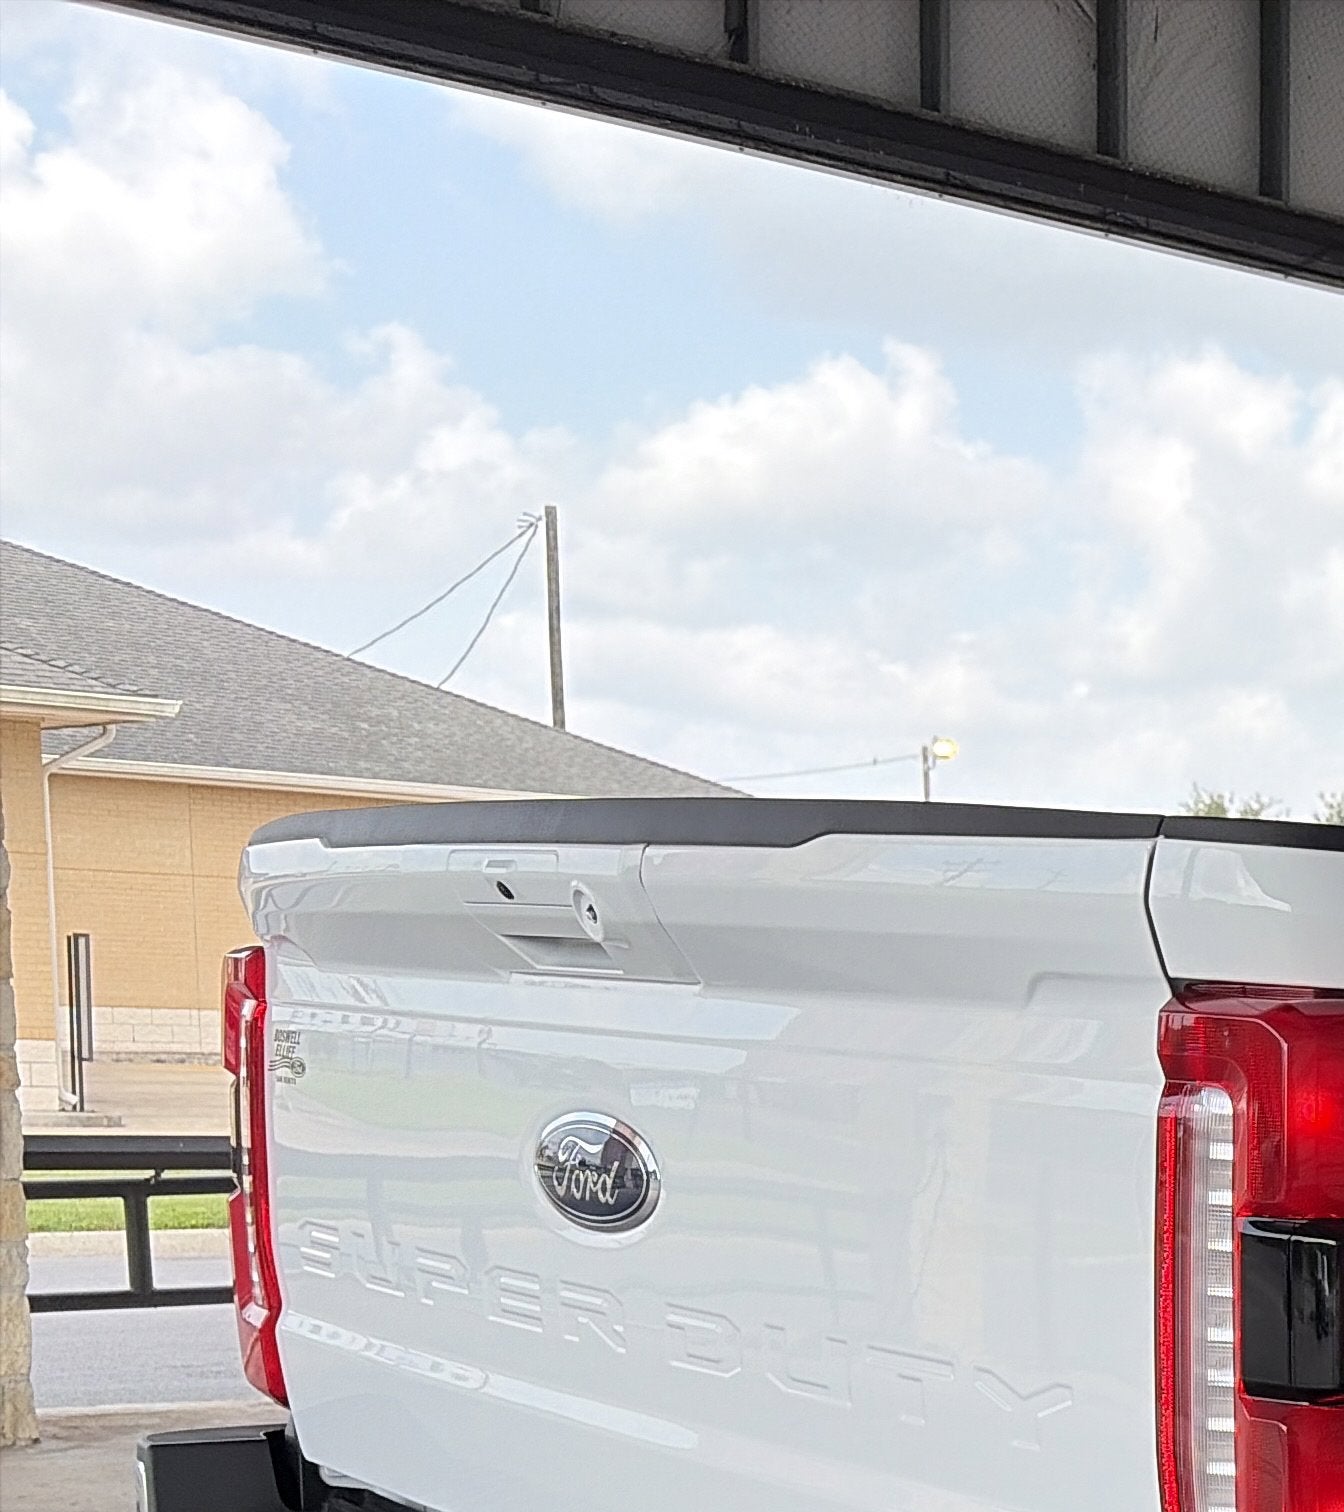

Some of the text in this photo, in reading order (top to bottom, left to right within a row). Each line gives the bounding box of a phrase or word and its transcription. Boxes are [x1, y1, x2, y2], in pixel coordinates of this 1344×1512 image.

[553, 1136, 619, 1206] Ford
[297, 1219, 1074, 1454] SUPER DUTY
